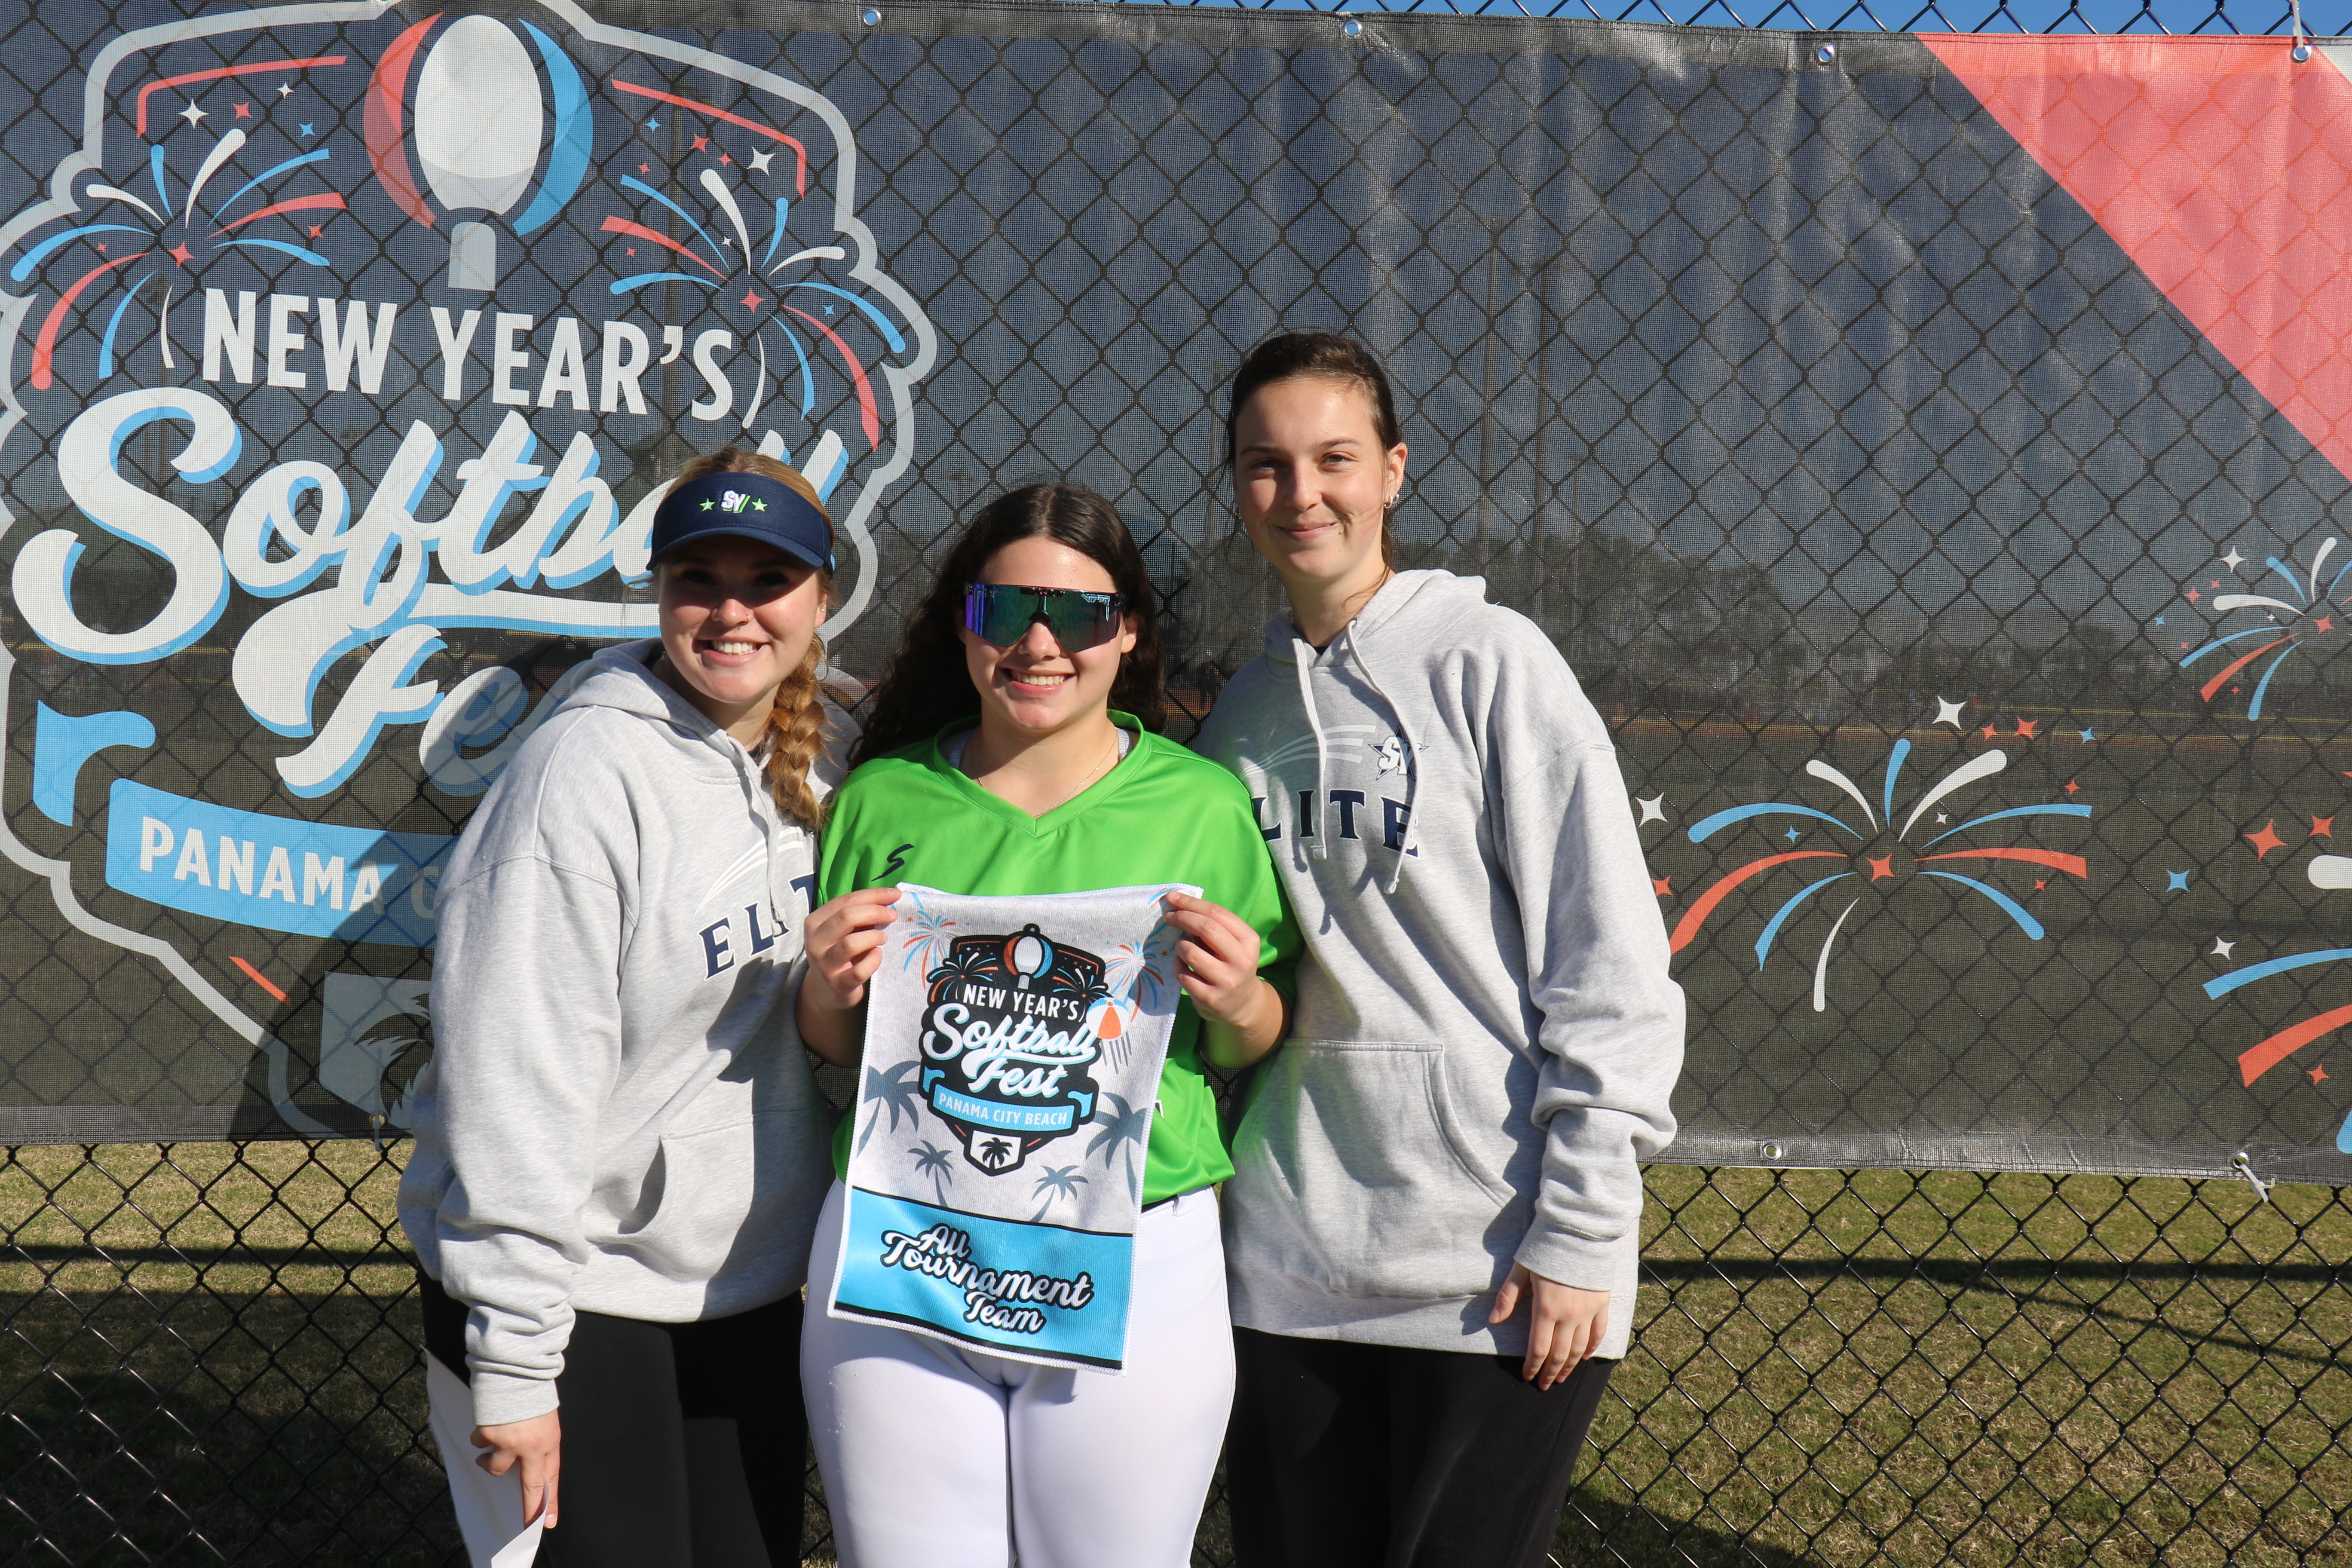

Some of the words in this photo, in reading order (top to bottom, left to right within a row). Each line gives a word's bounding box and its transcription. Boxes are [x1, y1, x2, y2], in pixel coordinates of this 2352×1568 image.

[202, 287, 398, 395] NEW
[430, 306, 733, 421] YEAR'S
[12, 387, 849, 665] Softb
[232, 584, 589, 799] Fe
[1251, 789, 1420, 859] LITE
[140, 815, 384, 918] PANAMA
[922, 1002, 1097, 1065] Softball
[963, 983, 1006, 1009] NEW
[1013, 991, 1079, 1021] YEAR'S
[961, 1047, 1068, 1098] Fest
[939, 1092, 989, 1119] PANAMA
[993, 1109, 1021, 1124] CITY
[1025, 1112, 1067, 1126] BEACH
[882, 1231, 1092, 1307] Tournament
[918, 1225, 970, 1258] All
[965, 1291, 1044, 1332] Team
